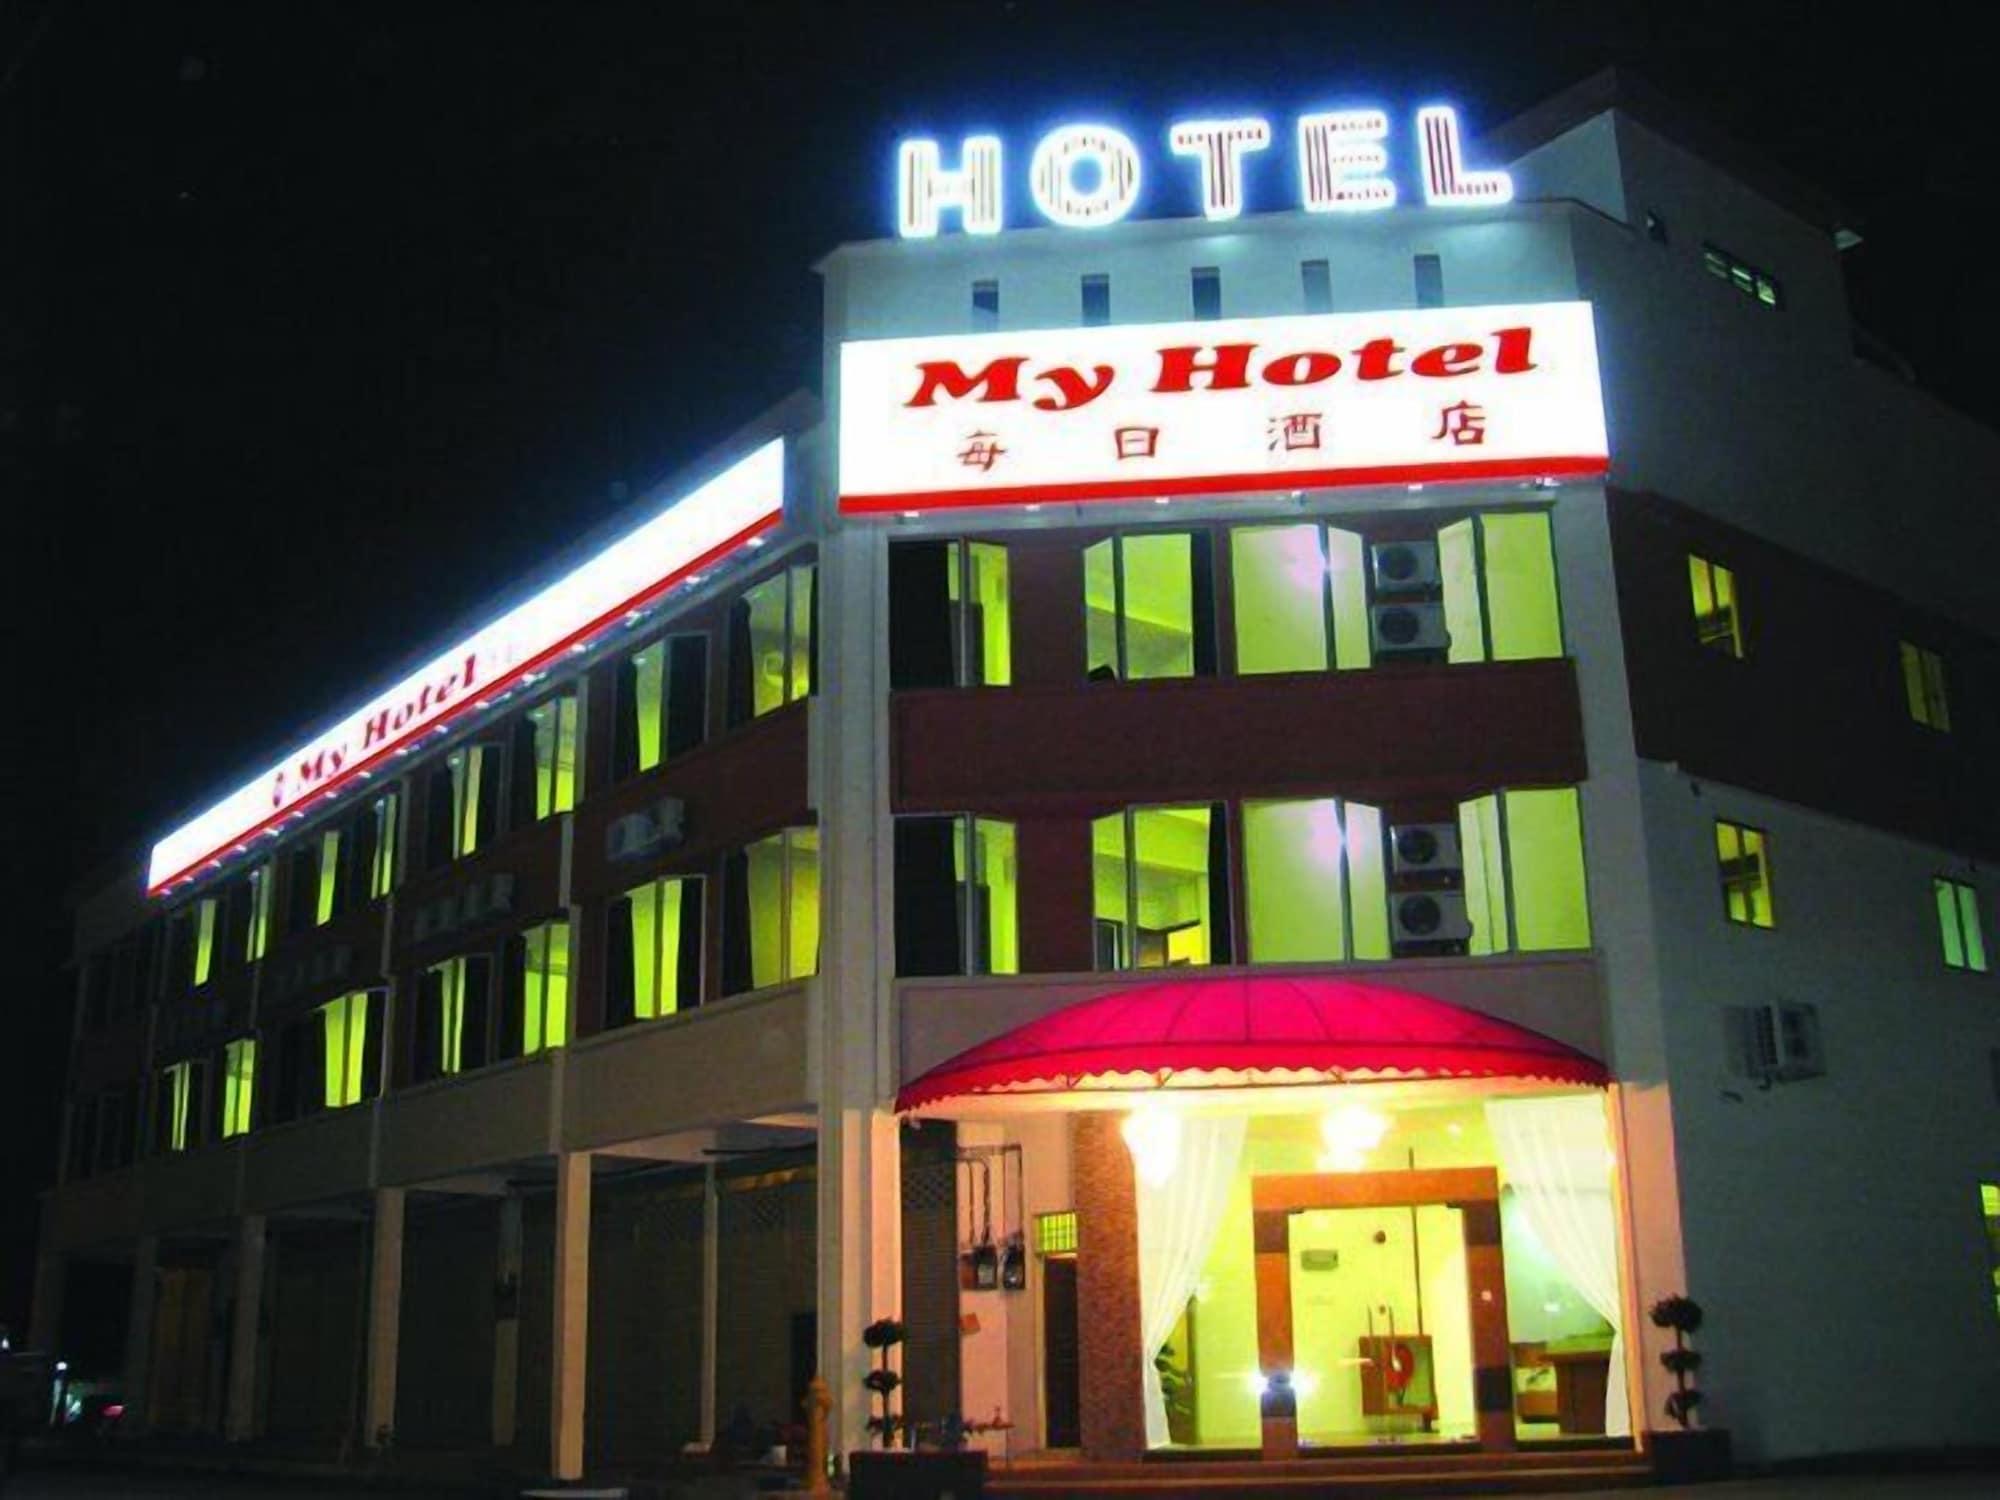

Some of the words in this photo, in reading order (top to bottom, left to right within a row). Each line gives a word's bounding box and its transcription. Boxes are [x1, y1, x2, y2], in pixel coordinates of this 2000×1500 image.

[899, 106, 1513, 237] HOTEL
[905, 356, 1114, 411] My
[1150, 326, 1537, 394] Hotel
[957, 400, 1486, 472] 每日酒店
[298, 744, 347, 790] My
[363, 653, 476, 749] Hotel
